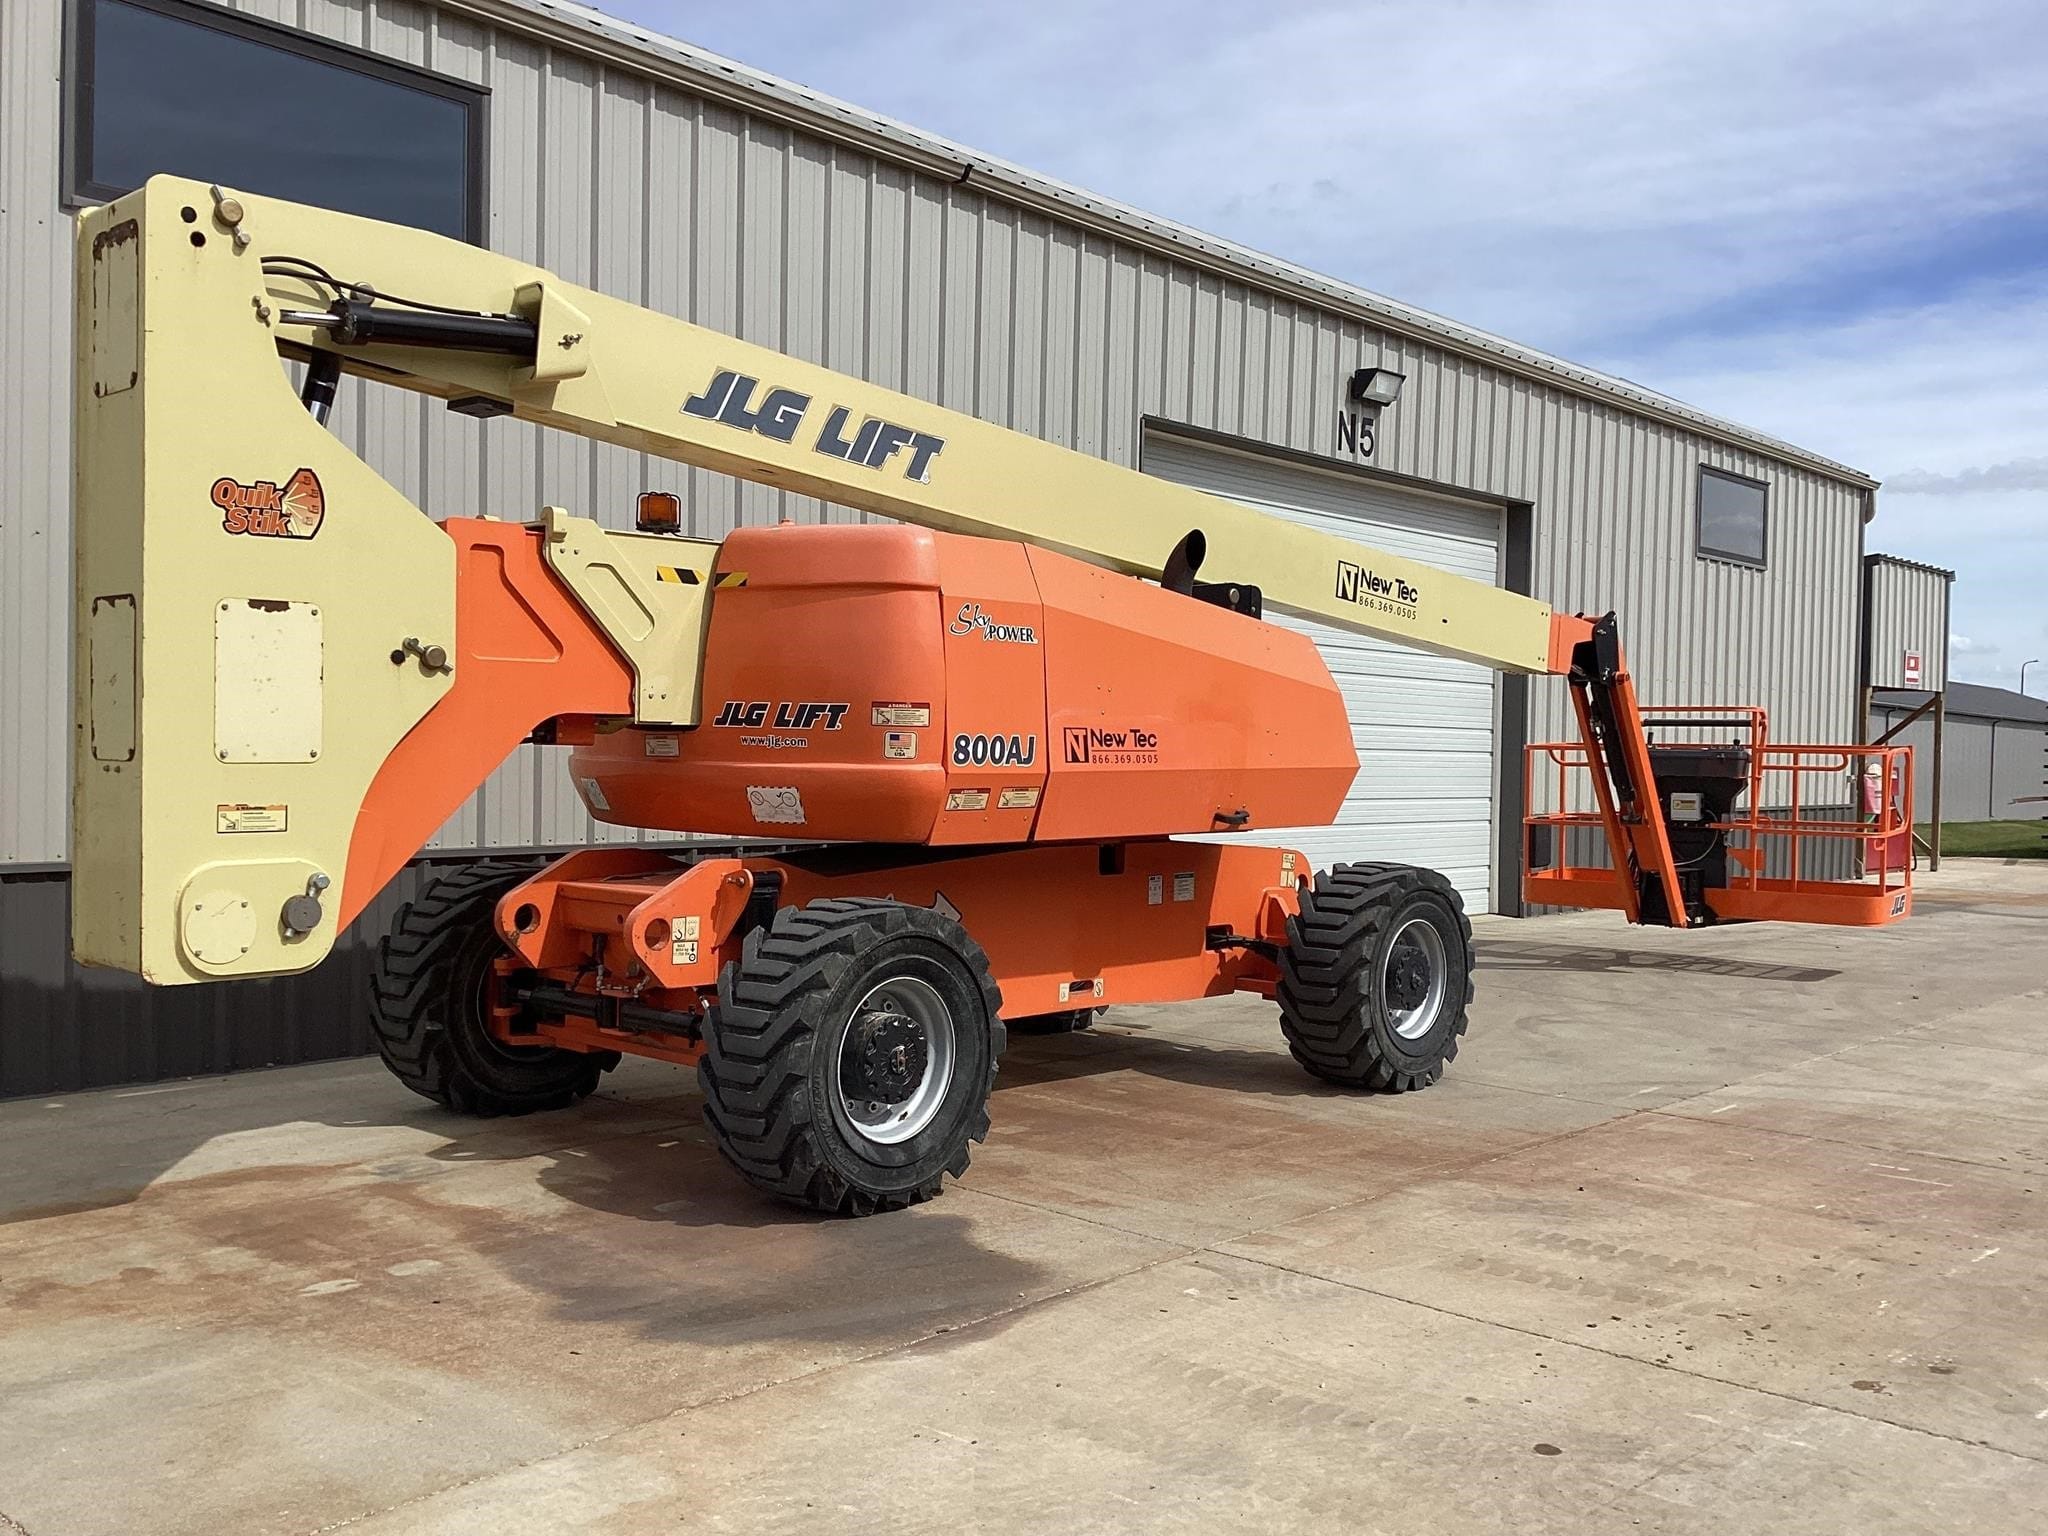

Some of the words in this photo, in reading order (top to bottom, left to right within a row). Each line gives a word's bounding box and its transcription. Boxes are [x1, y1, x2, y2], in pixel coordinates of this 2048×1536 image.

[681, 370, 813, 443] JLG
[816, 405, 947, 483] LIFT
[1338, 410, 1375, 458] N5
[213, 480, 284, 510] Quik
[224, 506, 291, 536] Stik
[1361, 567, 1393, 596] New
[1395, 578, 1418, 603] Tec
[1358, 595, 1417, 620] 866.369.0505
[989, 625, 1034, 642] POWER
[713, 701, 770, 728] JLG
[772, 702, 850, 730] LIFT
[740, 735, 808, 748] www.jlg.com
[953, 733, 1036, 766] 800AJ
[1090, 728, 1127, 747] New
[1129, 728, 1158, 748] Tec
[1092, 754, 1158, 764] 866.369.0505
